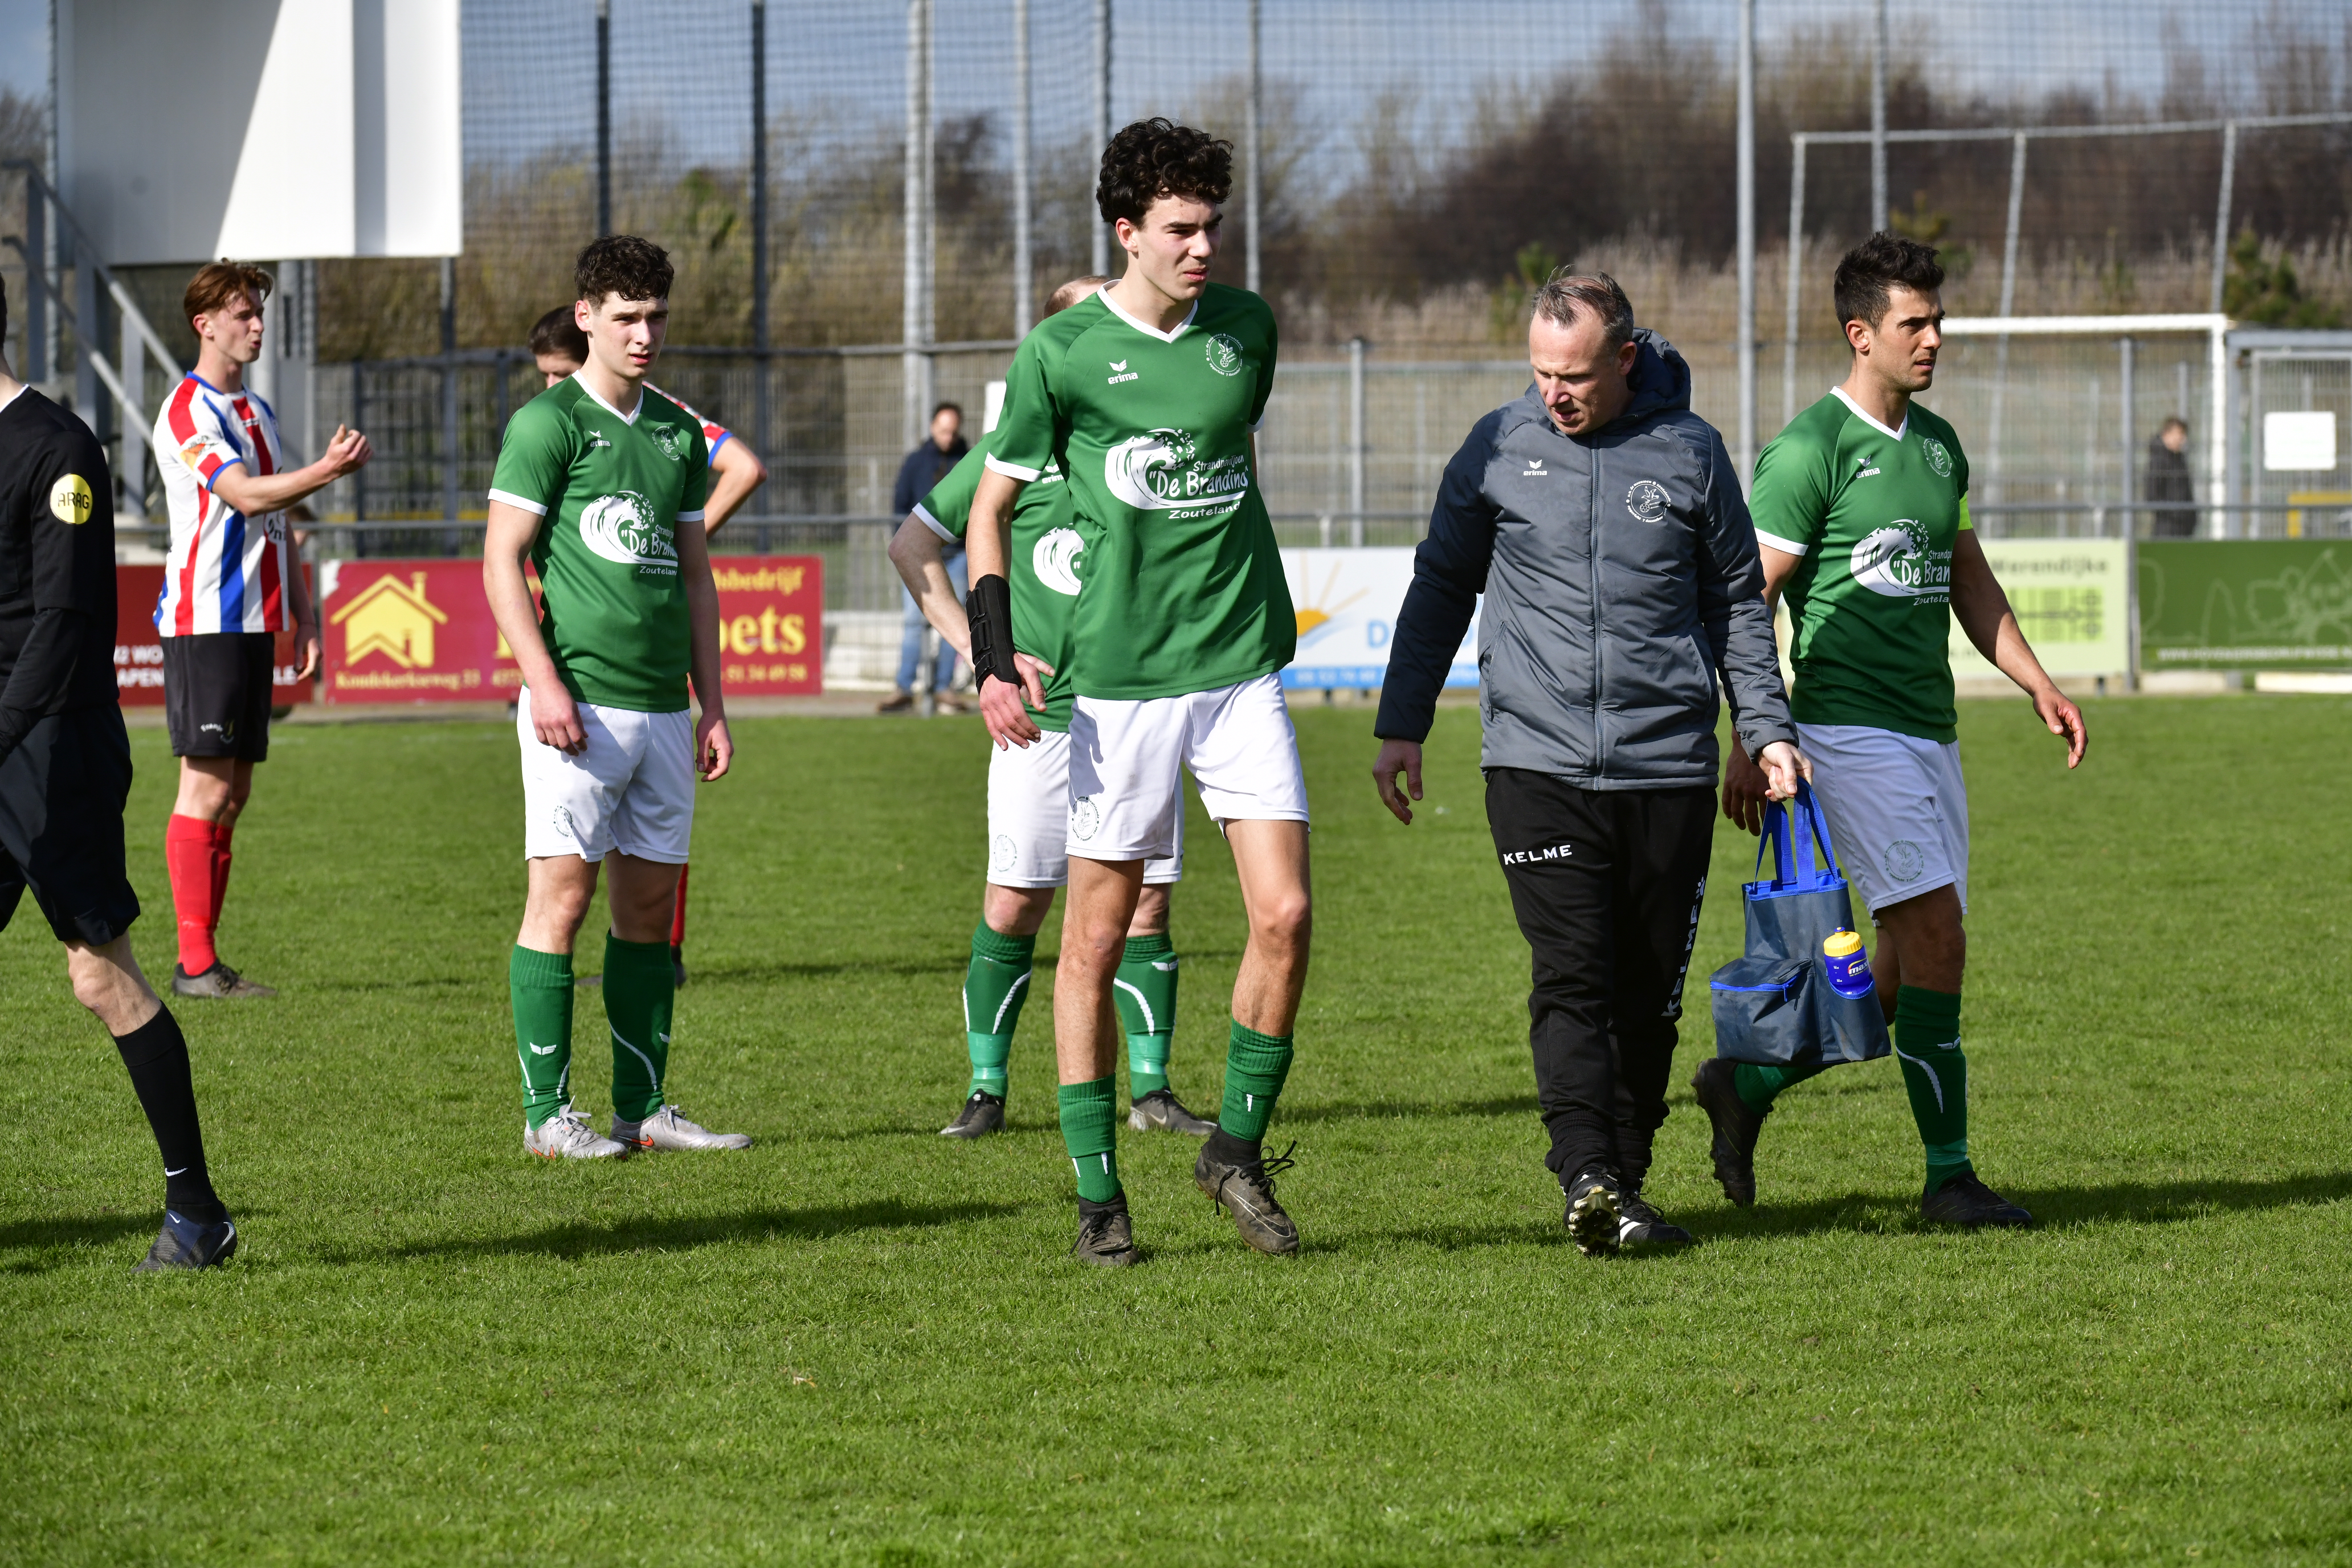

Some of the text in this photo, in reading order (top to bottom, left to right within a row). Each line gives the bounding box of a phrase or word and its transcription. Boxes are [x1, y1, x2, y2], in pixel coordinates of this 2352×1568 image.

[1108, 372, 1138, 385] erima
[590, 438, 611, 447] erima
[1856, 467, 1881, 479] erima
[1042, 475, 1064, 484] erim
[58, 492, 89, 509] ARAG
[1924, 560, 1950, 583] Bran
[1913, 595, 1949, 606] Zoutela
[1503, 844, 1572, 865] KELME
